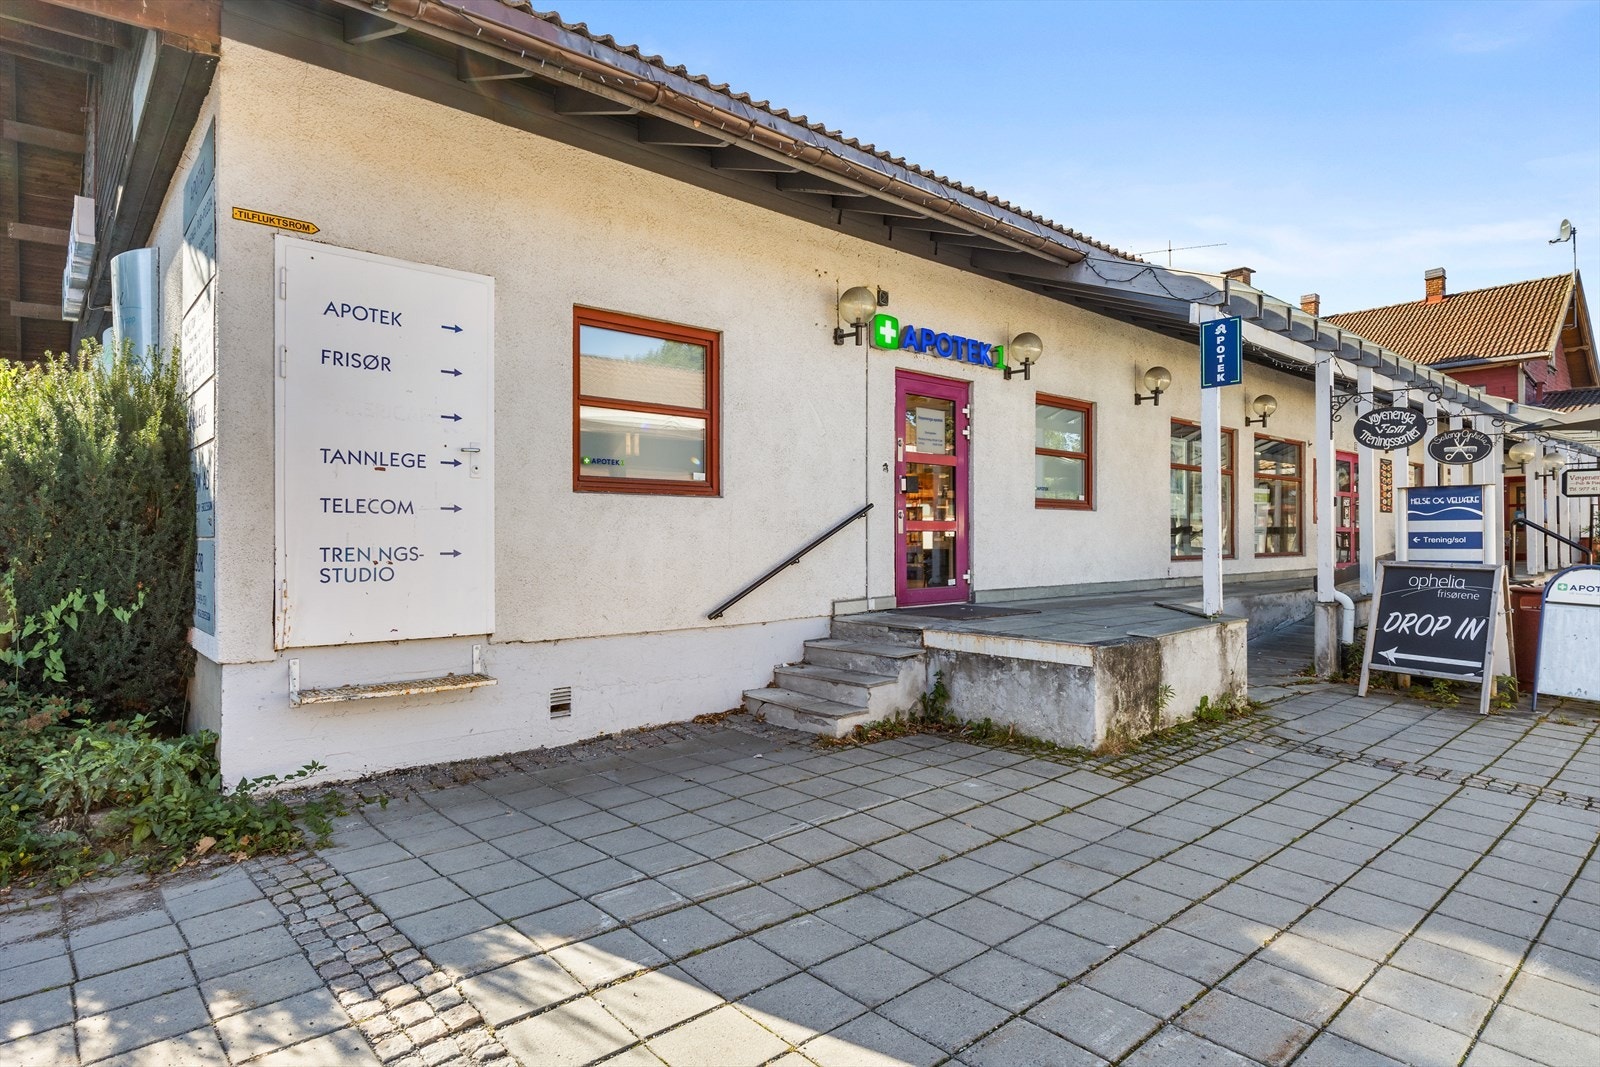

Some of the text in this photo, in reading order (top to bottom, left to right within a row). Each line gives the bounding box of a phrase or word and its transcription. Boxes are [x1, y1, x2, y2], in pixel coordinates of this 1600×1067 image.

[237, 209, 311, 232] TILFLUKTSROM
[323, 300, 403, 328] APOTEK
[902, 325, 1006, 370] APOTEK 1
[1214, 323, 1228, 382] APOTEK
[321, 348, 391, 373] FRISØR
[1360, 426, 1421, 449] Treningssenter
[319, 448, 427, 470] TANNLEGE
[591, 458, 620, 466] APOTEK
[319, 497, 415, 516] TELECOM
[1410, 497, 1431, 505] HELSE
[1423, 535, 1467, 545] Trening/sol
[319, 566, 395, 584] STUDIO
[1408, 573, 1466, 590] ophelia
[1437, 589, 1480, 601] frisørene
[1384, 611, 1486, 641] DROP IN
